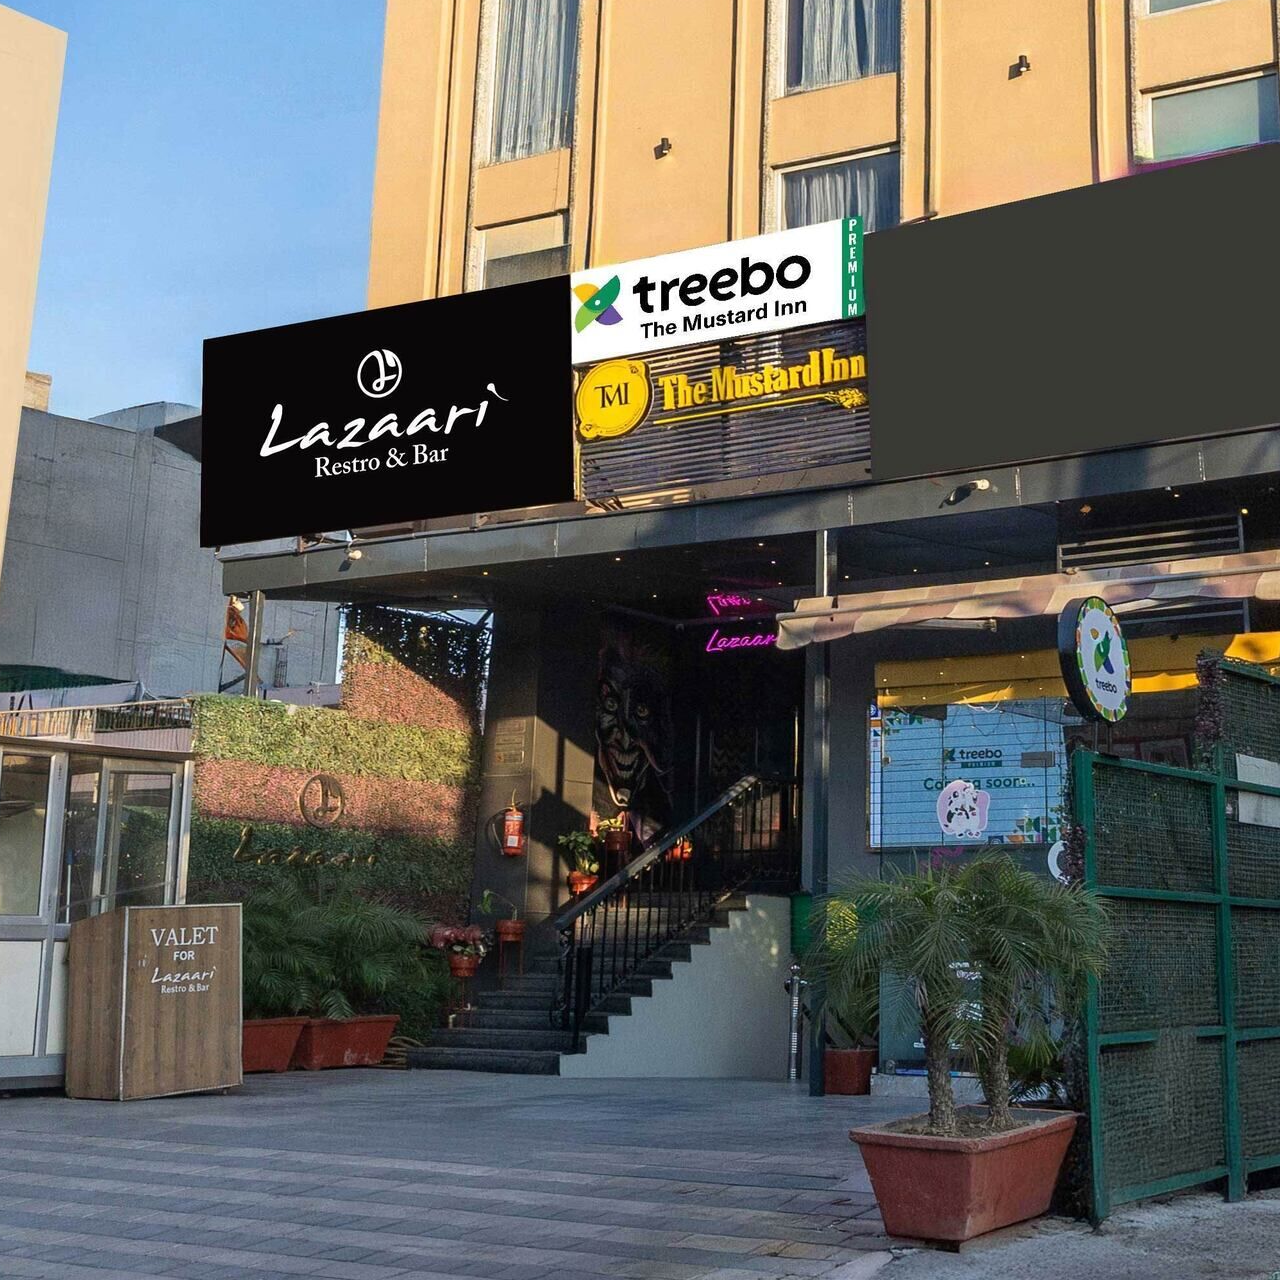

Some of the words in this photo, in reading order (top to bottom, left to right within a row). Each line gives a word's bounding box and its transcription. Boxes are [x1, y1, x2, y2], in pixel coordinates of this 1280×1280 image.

[848, 218, 858, 317] PREMIUM
[632, 254, 812, 314] treebo
[640, 320, 678, 339] The
[683, 303, 768, 333] Mustard
[774, 299, 808, 317] Inn
[658, 373, 707, 411] The
[711, 350, 821, 404] Mustard
[821, 347, 867, 383] Inn
[314, 455, 381, 478] Restro
[386, 447, 409, 469] &
[412, 443, 450, 466] Bar
[706, 629, 780, 652] Lazaar
[1095, 678, 1118, 694] treebo
[958, 748, 1003, 760] treebo
[150, 926, 219, 947] VALET
[173, 950, 195, 961] FOR
[161, 984, 186, 994] Restro
[188, 983, 195, 993] &
[196, 983, 210, 992] Bar
